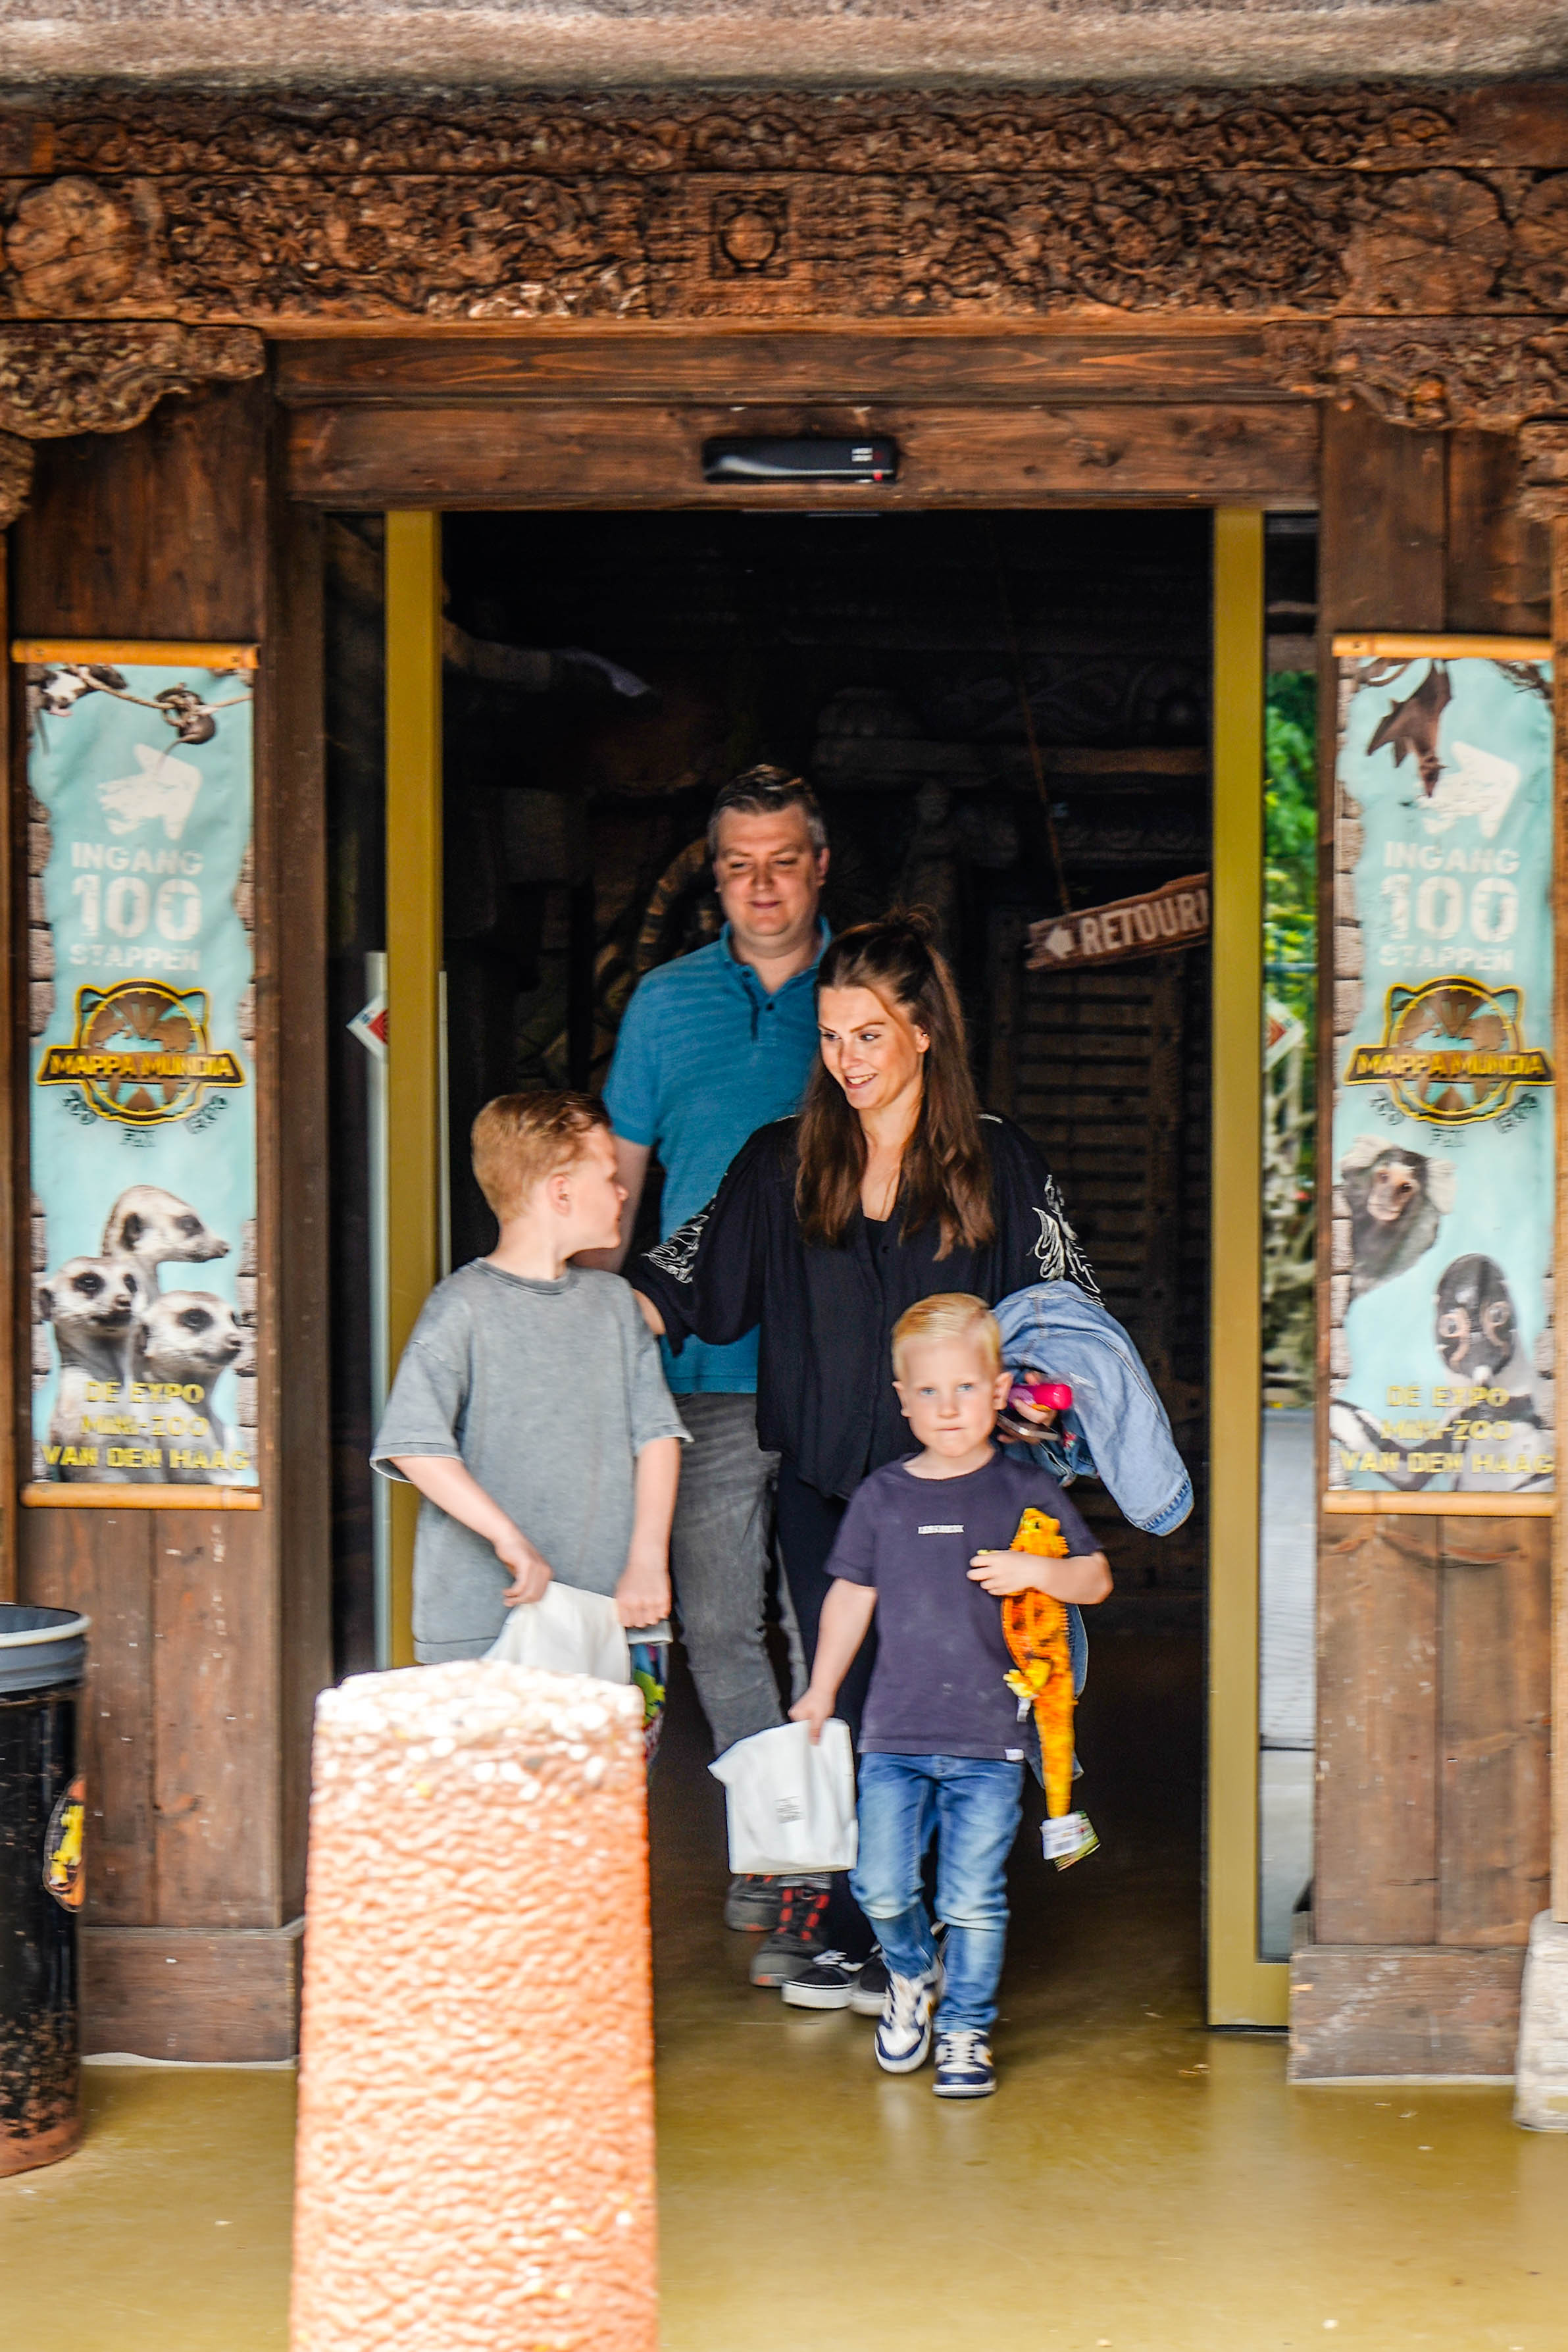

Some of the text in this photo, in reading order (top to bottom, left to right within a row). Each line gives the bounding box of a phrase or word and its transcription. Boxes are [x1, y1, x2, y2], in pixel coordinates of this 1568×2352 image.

[70, 842, 203, 876] INGANG
[1384, 840, 1520, 875] INGANG
[70, 874, 203, 941] 100
[1380, 873, 1519, 943] 100
[68, 943, 201, 971] STAPPEN
[1379, 944, 1514, 971] STAPPEN
[49, 1054, 236, 1077] MAPPA MUNDIA
[1355, 1054, 1545, 1075] MAPPA MUNDIA
[129, 1381, 205, 1404] EXPO
[1432, 1386, 1510, 1408] EXPO
[41, 1446, 253, 1470] VAN DEN HAAG
[1340, 1451, 1555, 1475] VAN DEN HAAG
